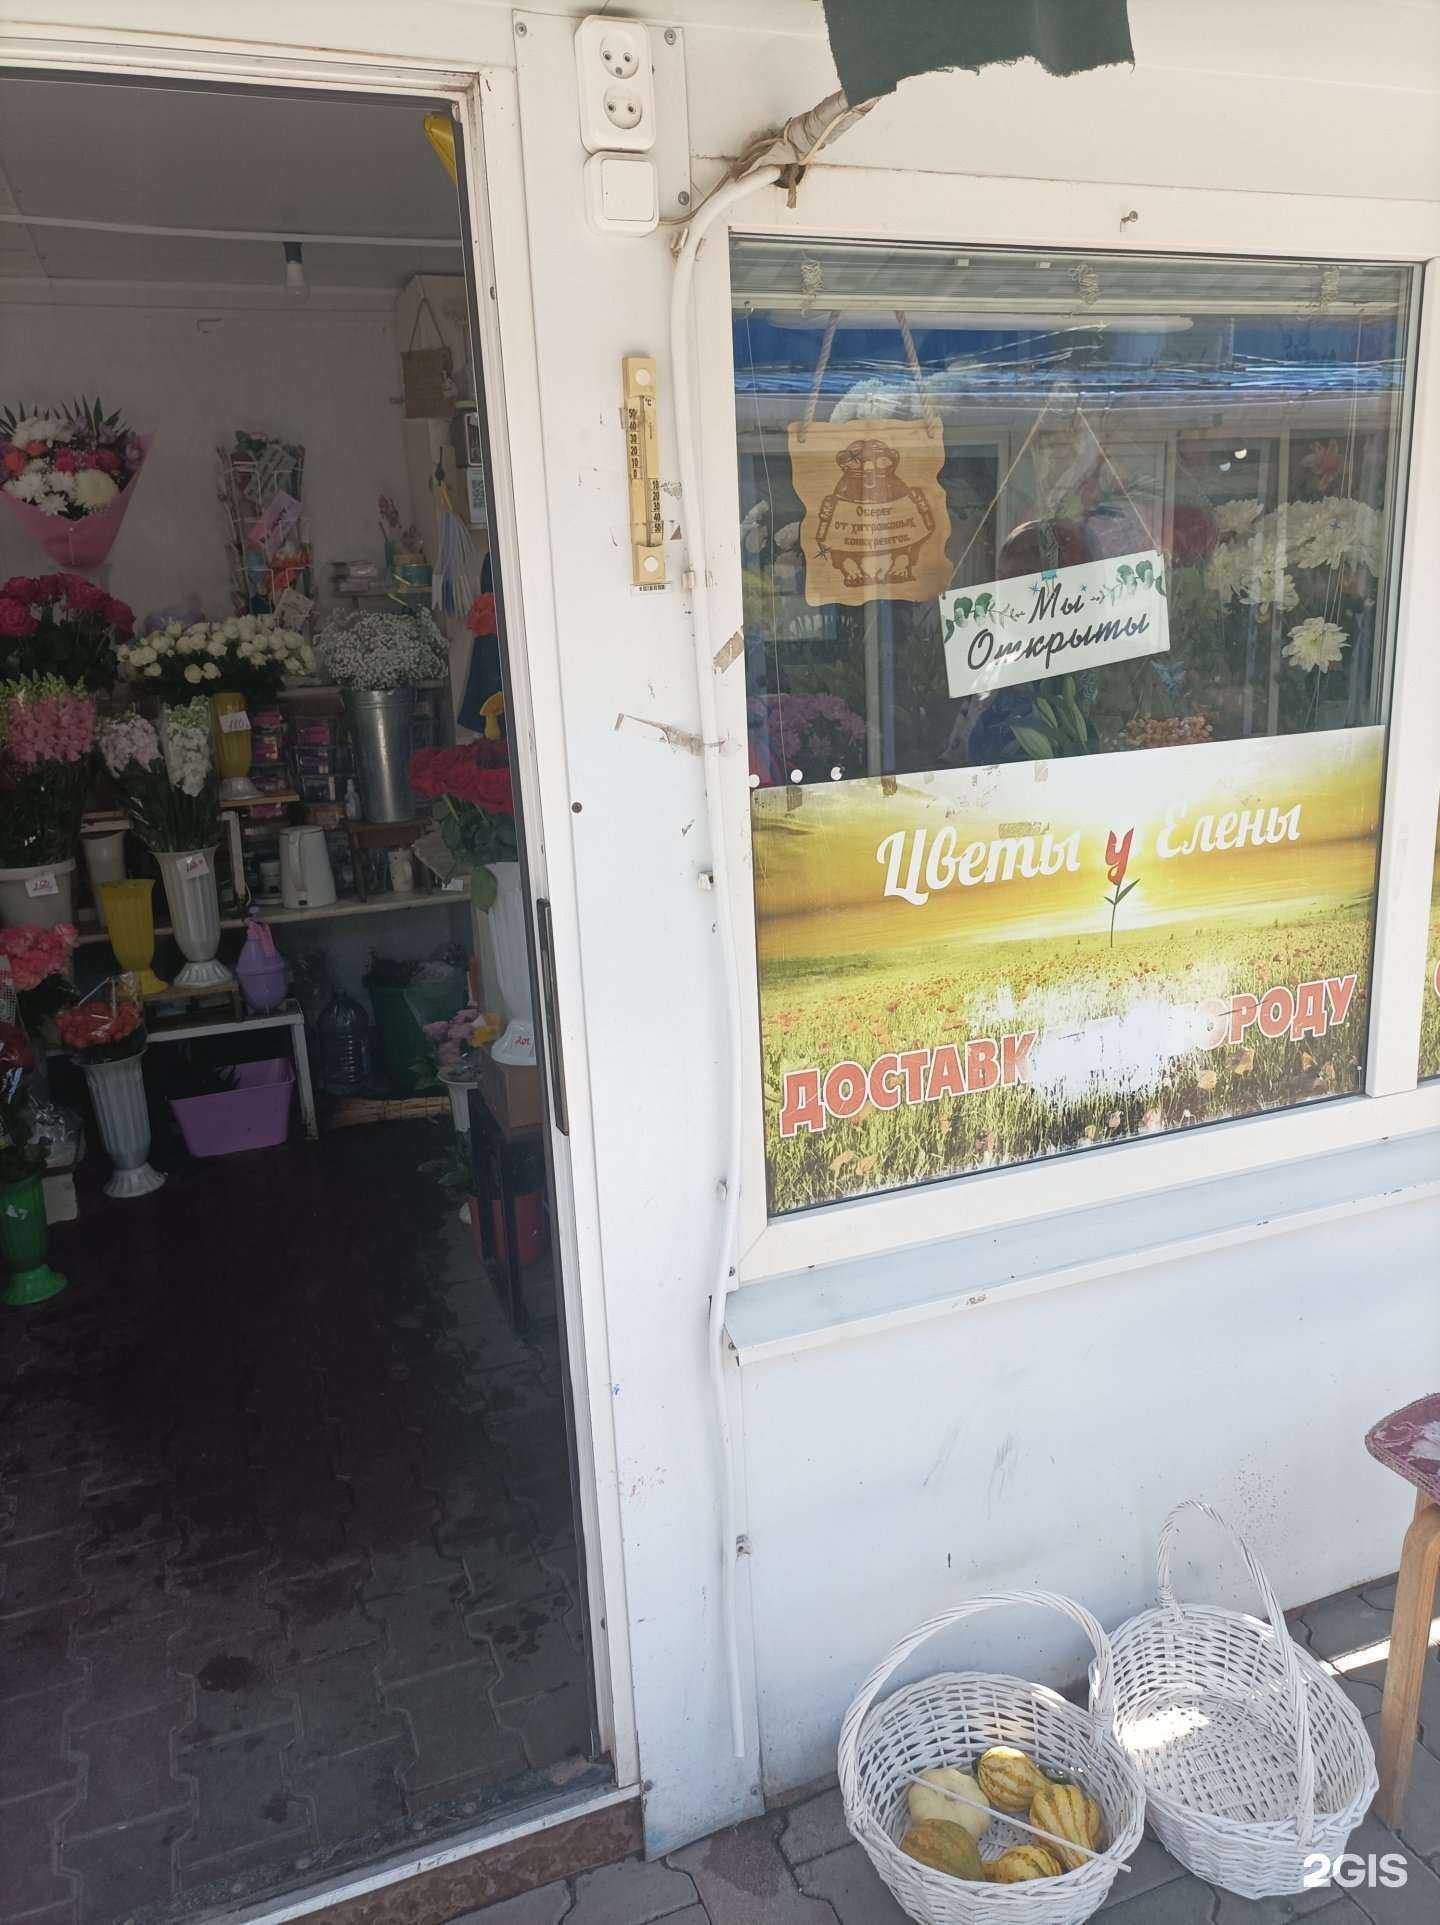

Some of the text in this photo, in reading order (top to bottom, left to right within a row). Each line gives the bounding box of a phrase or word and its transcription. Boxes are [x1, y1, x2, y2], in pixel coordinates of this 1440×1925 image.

[834, 520, 848, 531] от
[1027, 582, 1084, 624] Мы
[967, 613, 1150, 670] Открыты
[876, 824, 1081, 906] Цветы
[1156, 803, 1302, 858] Елены
[779, 1031, 1037, 1137] ДОСТАВК
[1196, 974, 1358, 1052] ОРОДУ
